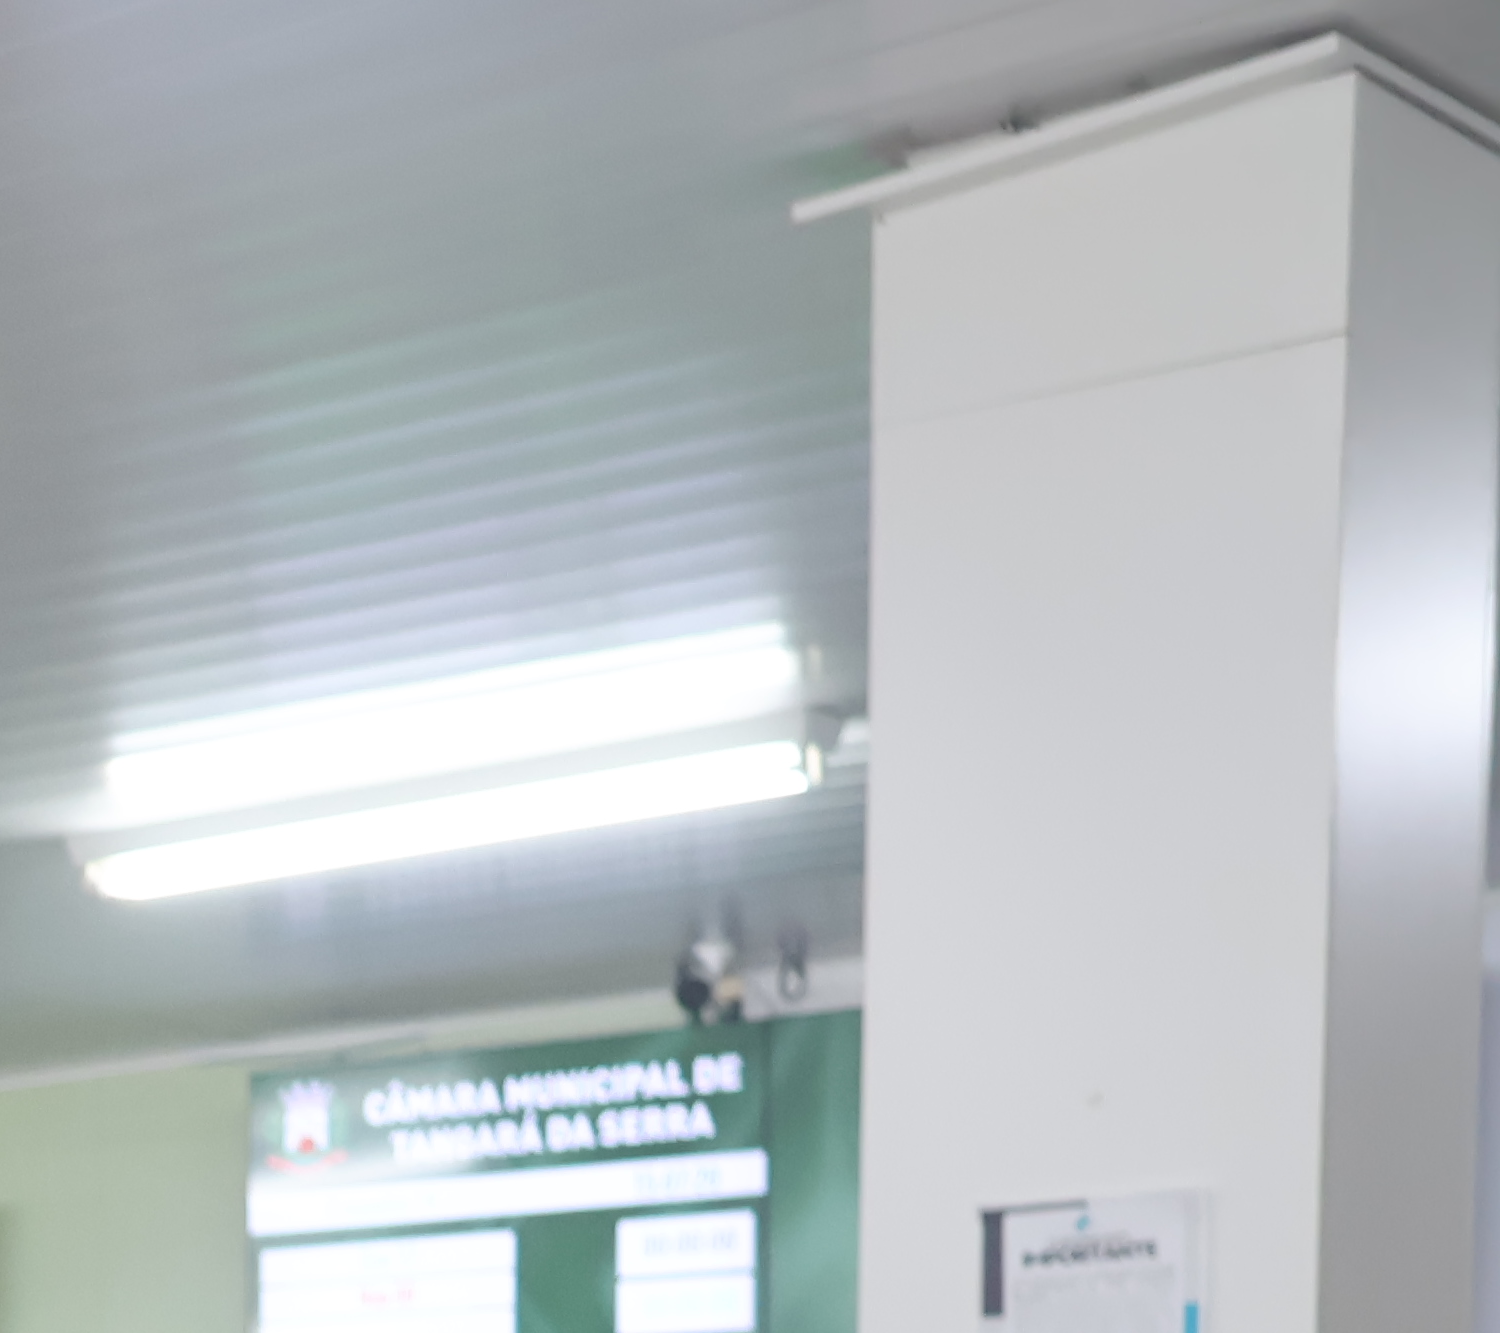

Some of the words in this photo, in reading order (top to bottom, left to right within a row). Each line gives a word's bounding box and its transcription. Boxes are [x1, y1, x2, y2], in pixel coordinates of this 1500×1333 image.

[692, 1052, 743, 1094] DE
[545, 1111, 597, 1152] DA
[598, 1101, 716, 1148] SERRA
